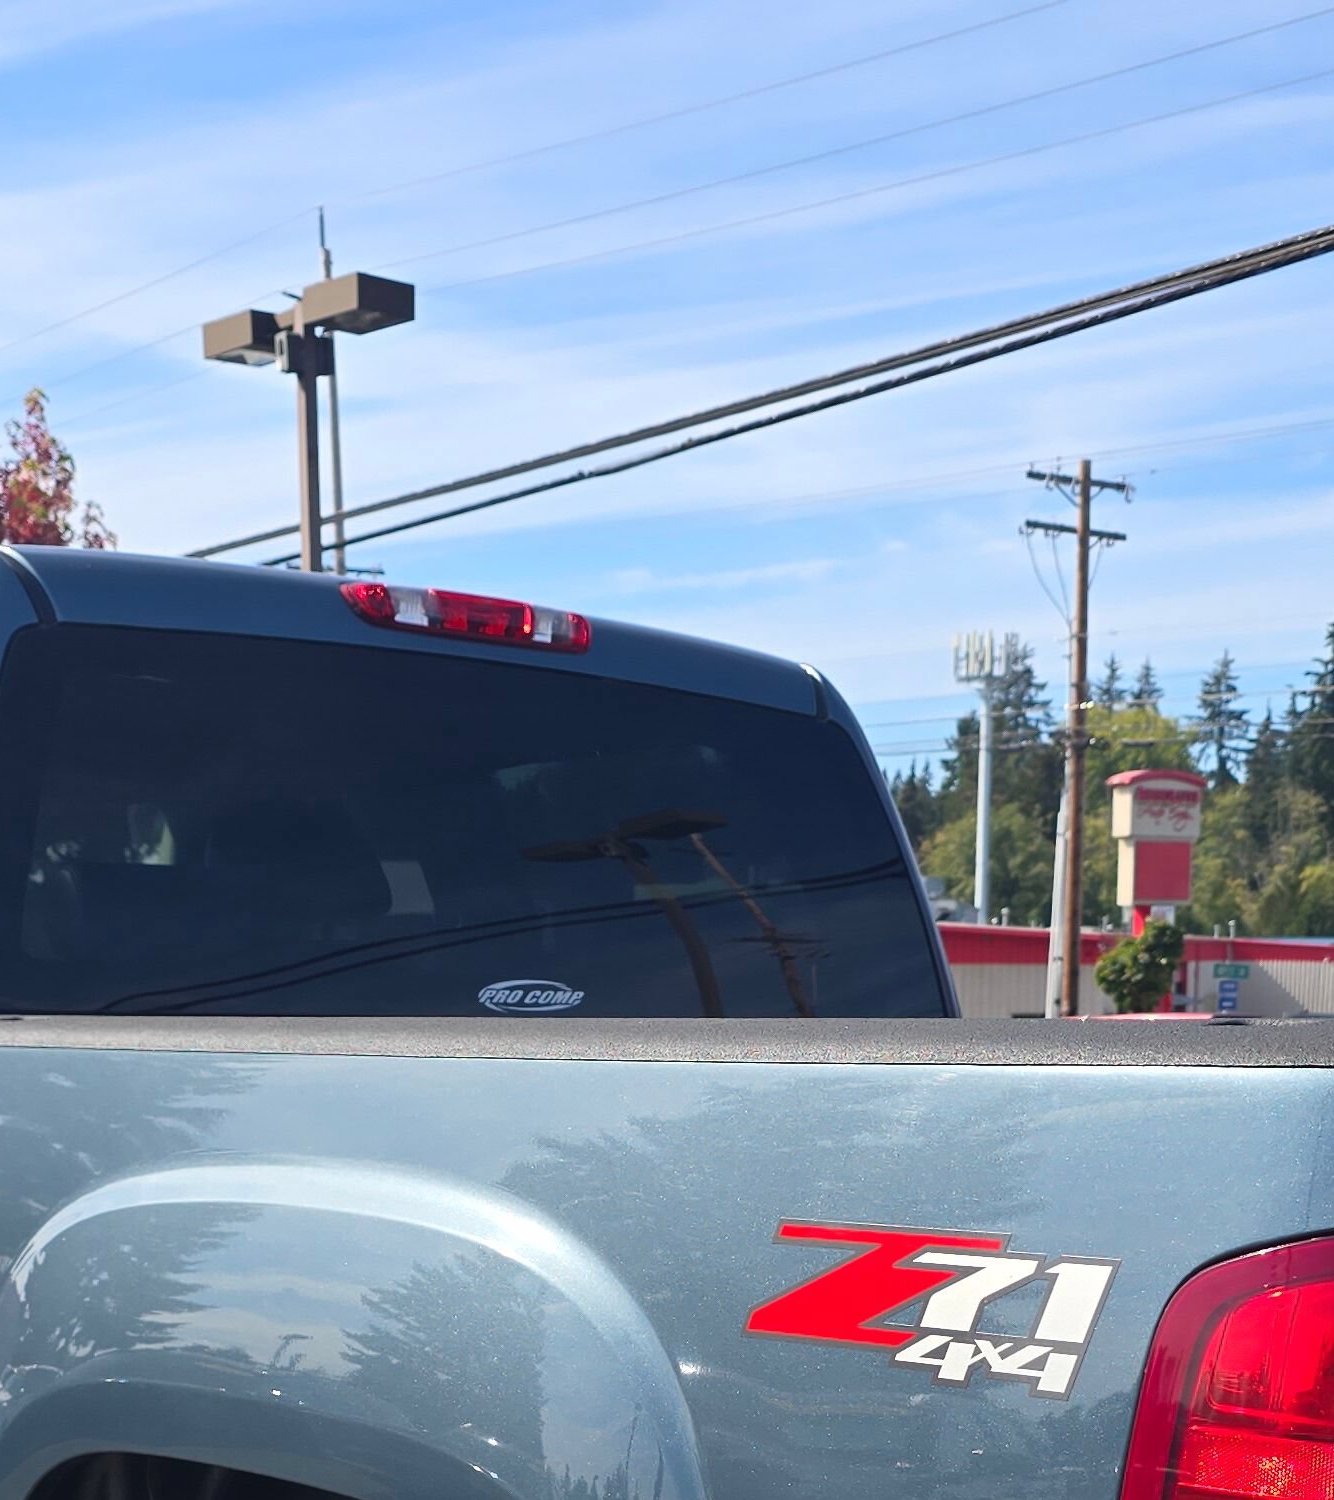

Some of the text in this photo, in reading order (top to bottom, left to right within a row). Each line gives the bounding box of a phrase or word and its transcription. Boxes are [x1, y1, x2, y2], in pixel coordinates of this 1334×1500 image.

[478, 989, 585, 1005] PRO COMP
[745, 1221, 1116, 1347] Z71
